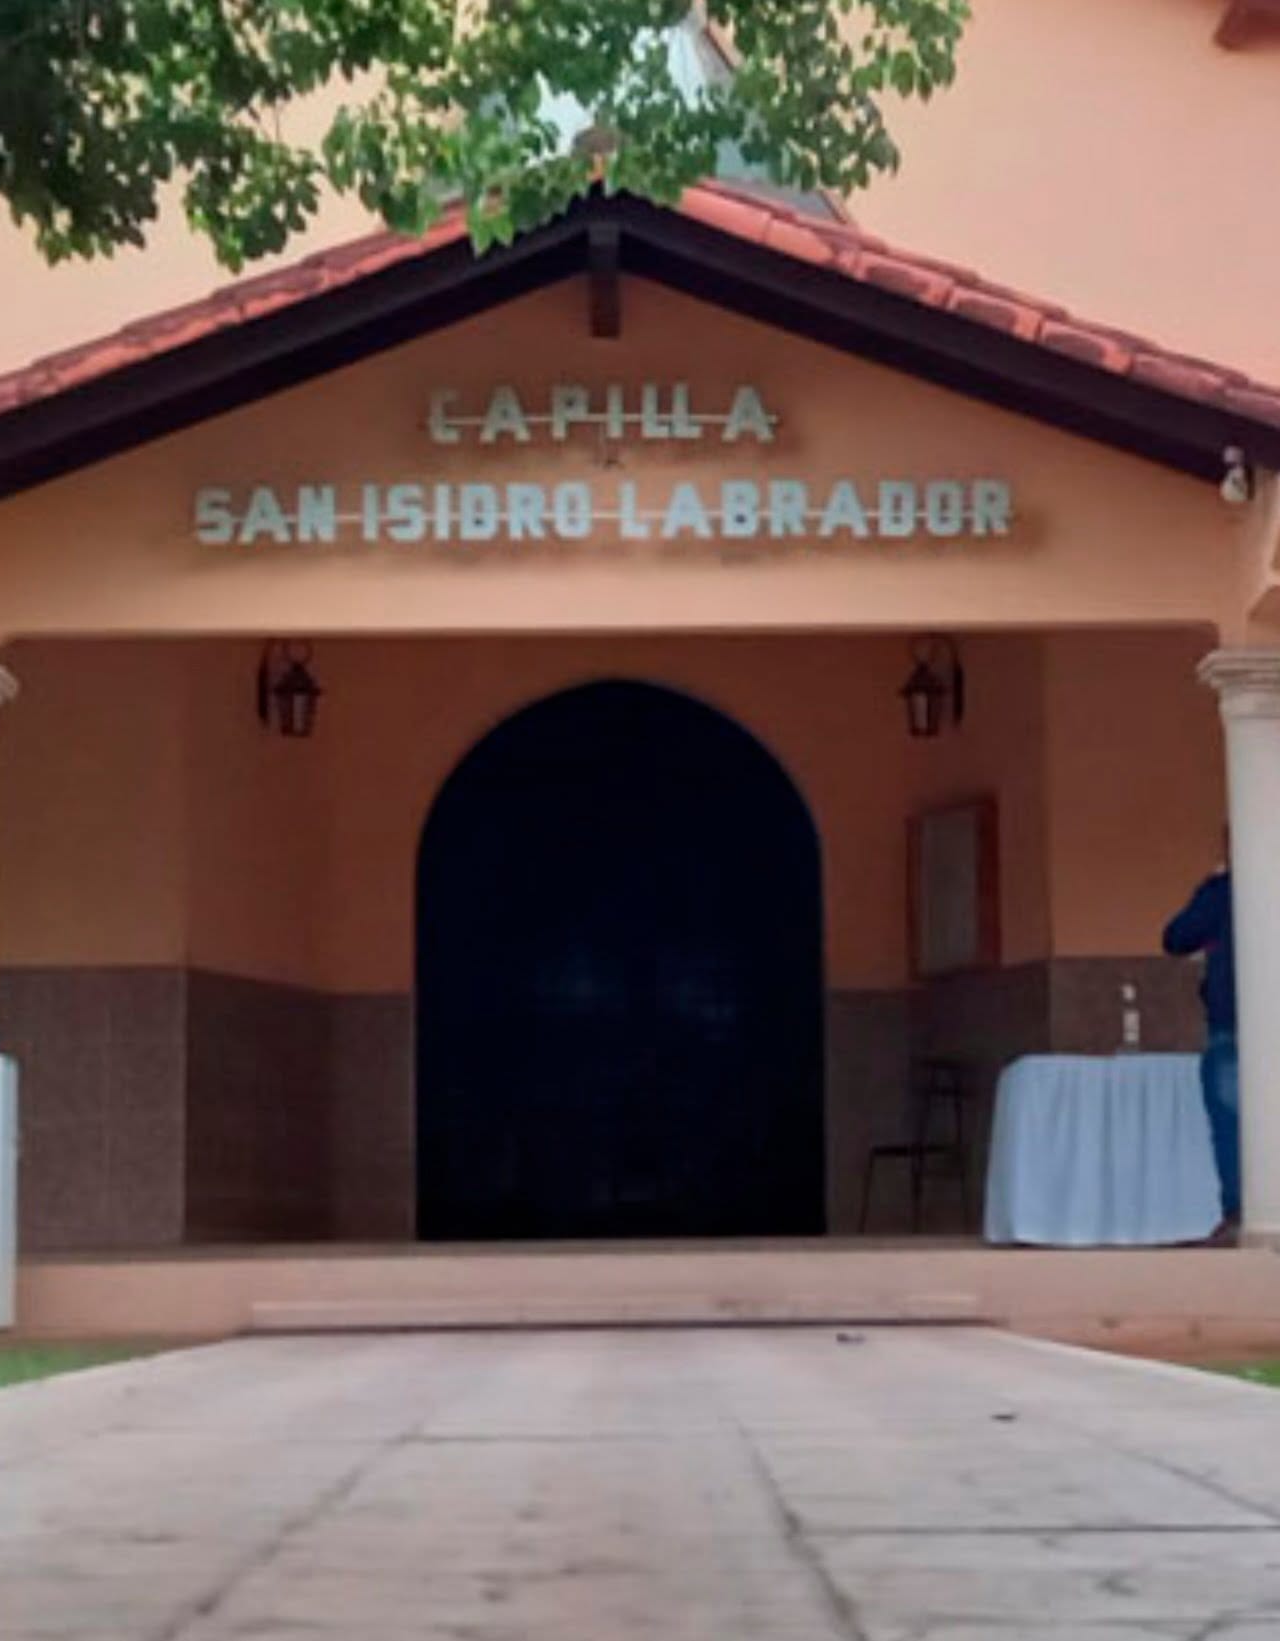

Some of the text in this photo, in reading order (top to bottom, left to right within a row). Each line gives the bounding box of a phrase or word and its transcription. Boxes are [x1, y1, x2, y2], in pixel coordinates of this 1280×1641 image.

[429, 385, 774, 443] CAPILLA
[196, 480, 1011, 543] SAN ISIDRO LABRADOR
